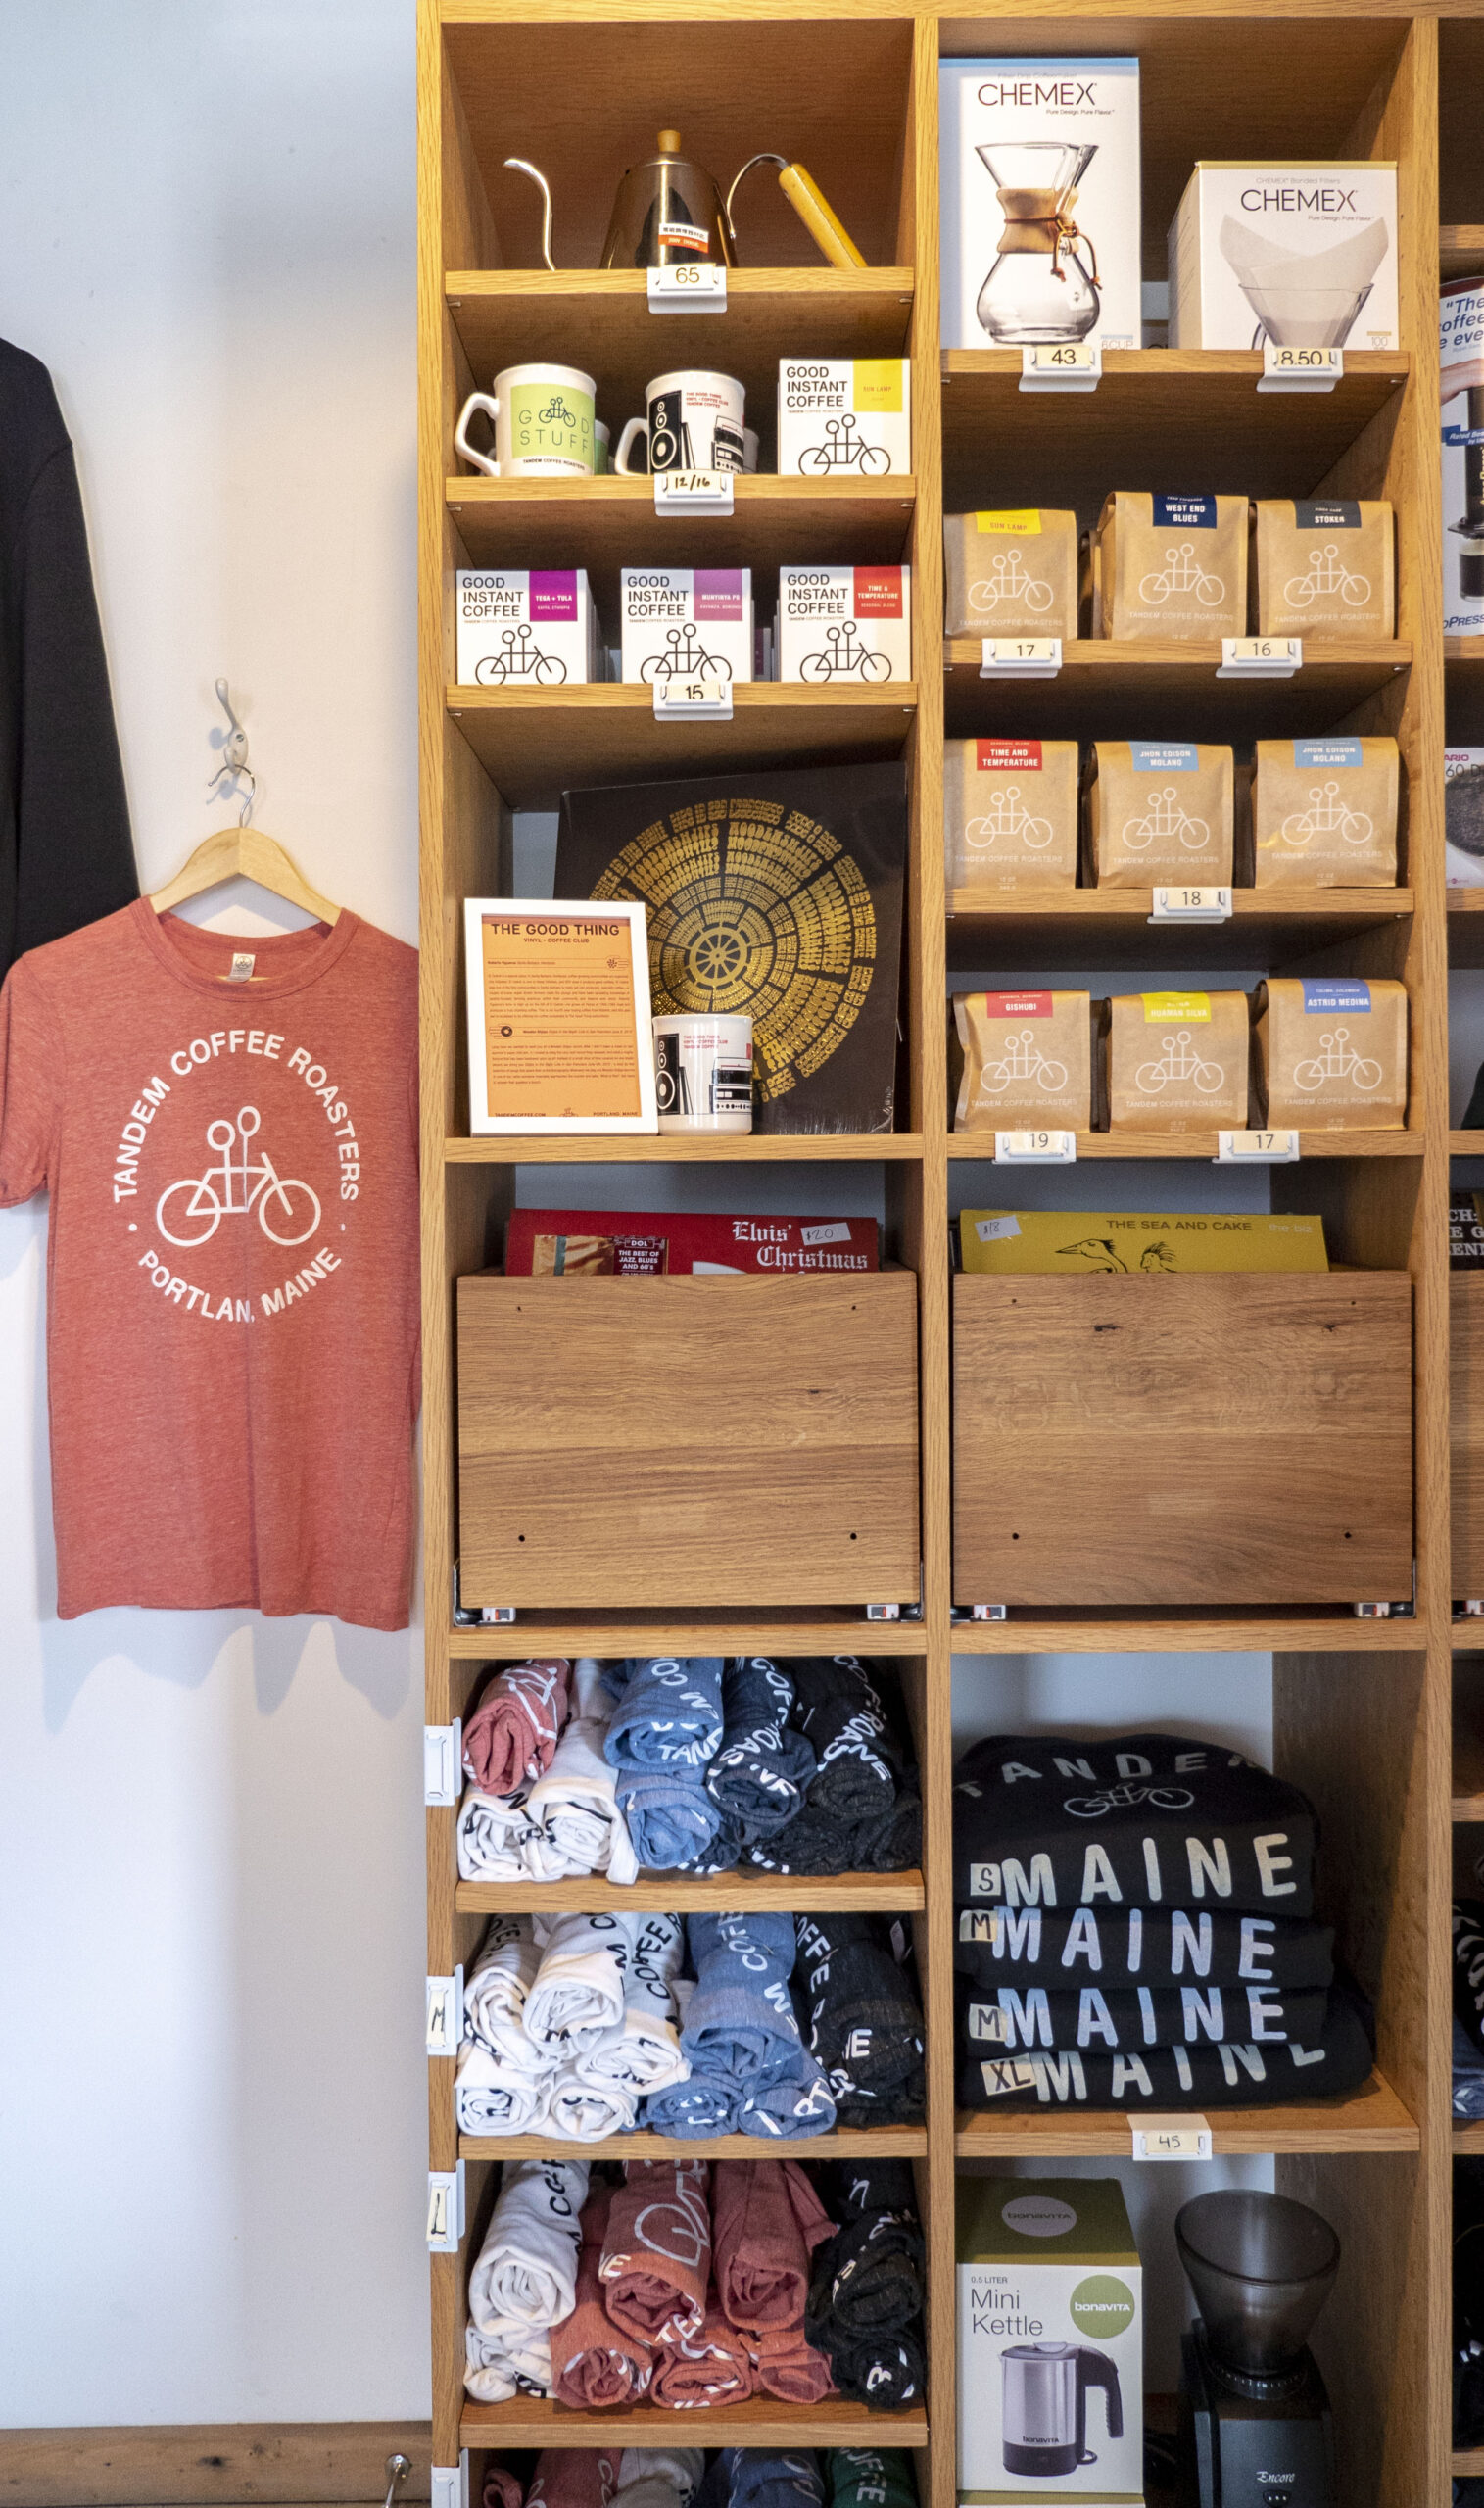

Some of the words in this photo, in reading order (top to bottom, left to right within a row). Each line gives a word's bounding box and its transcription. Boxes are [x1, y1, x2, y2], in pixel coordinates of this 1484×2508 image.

[978, 82, 1096, 106] CHEMEX
[1240, 189, 1356, 212] CHEMEX
[676, 267, 700, 283] 65
[1439, 312, 1484, 333] offee
[1051, 349, 1077, 365] 43
[1281, 350, 1323, 366] 8.50
[787, 366, 830, 378] GOOD
[788, 381, 848, 393] INSTANT
[787, 395, 844, 408] COFFEE
[520, 429, 589, 454] STUFF
[675, 474, 711, 491] 12/16
[1165, 504, 1187, 512] WEST
[1189, 505, 1206, 513] END
[1173, 514, 1198, 523] BLUES
[1314, 515, 1346, 524] STOKER
[462, 577, 505, 589] GOOD
[627, 576, 670, 588] GOOD
[788, 574, 830, 586] GOOD
[463, 591, 524, 603] INSTANT
[628, 590, 689, 602] INSTANT
[788, 588, 848, 600] INSTANT
[462, 605, 520, 617] COFFEE
[628, 604, 685, 616] COFFEE
[788, 603, 845, 614] COFFEE
[1017, 644, 1035, 657] 17
[1252, 642, 1271, 657] 16
[686, 685, 704, 699] 15
[982, 758, 1038, 767] TEMPERATURE
[1182, 891, 1201, 905] 18
[491, 923, 521, 935] THE
[526, 924, 570, 935] GOOD
[574, 924, 620, 936] THING
[1005, 1002, 1037, 1011] GISHUBI
[1307, 998, 1337, 1007] ASTRID
[1338, 997, 1369, 1006] MEDINA
[113, 1076, 171, 1204] TANDEM
[170, 1029, 286, 1076] COFFEE
[287, 1046, 361, 1202] ROASTERS
[1029, 1133, 1049, 1148] 19
[1255, 1133, 1274, 1149] 17
[732, 1221, 792, 1242] Elvis'
[1106, 1220, 1136, 1229] THE
[1141, 1220, 1171, 1230] SEA
[1175, 1221, 1208, 1230] AND
[1212, 1221, 1253, 1231] CAKE
[756, 1245, 869, 1272] Christmas
[261, 1246, 343, 1317] MAINE
[954, 1752, 1257, 1798] TANDE
[1000, 1833, 1297, 1907] MAINE
[978, 1866, 995, 1892] S
[970, 1913, 993, 1940] M
[991, 1905, 1277, 1980] MAINE
[977, 2008, 1001, 2038] M
[997, 1986, 1288, 2049] MAINE
[990, 2059, 1031, 2092] XL
[1158, 2135, 1182, 2149] 45
[971, 2288, 1021, 2310] Mini
[973, 2313, 1044, 2337] Kettle
[1255, 2470, 1296, 2484] Encore
